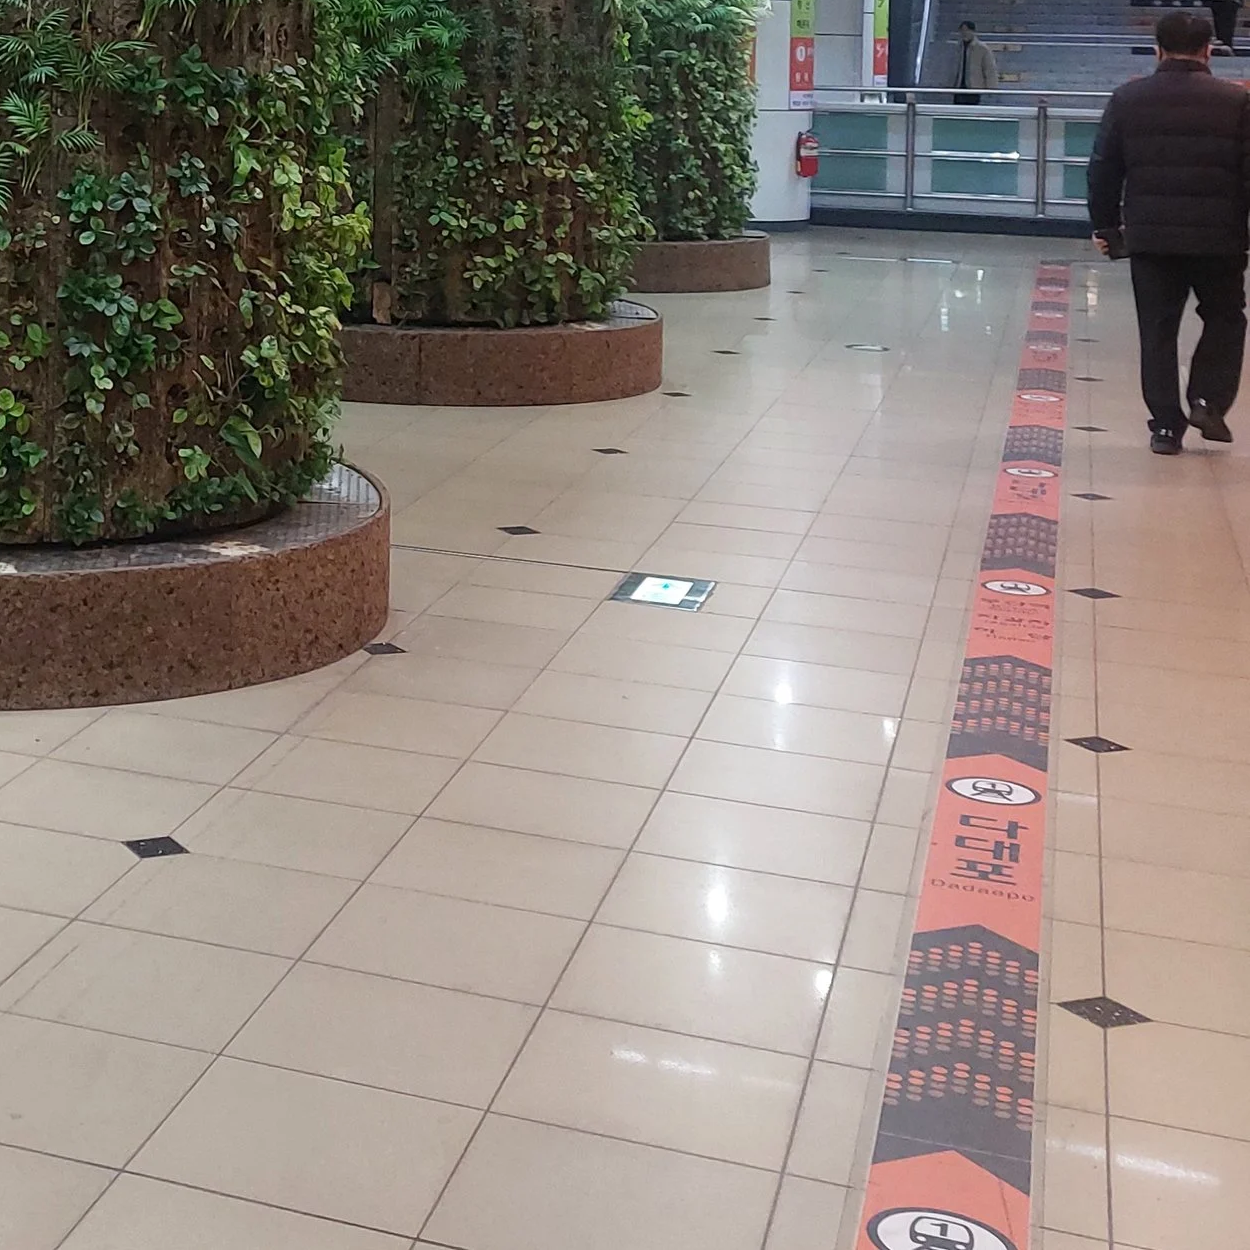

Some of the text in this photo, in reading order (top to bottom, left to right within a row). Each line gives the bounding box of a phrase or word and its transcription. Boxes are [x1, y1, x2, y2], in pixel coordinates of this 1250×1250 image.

[950, 814, 1029, 886] 다대포
[931, 878, 1035, 902] Dadaepo
[930, 1222, 948, 1237] 1
